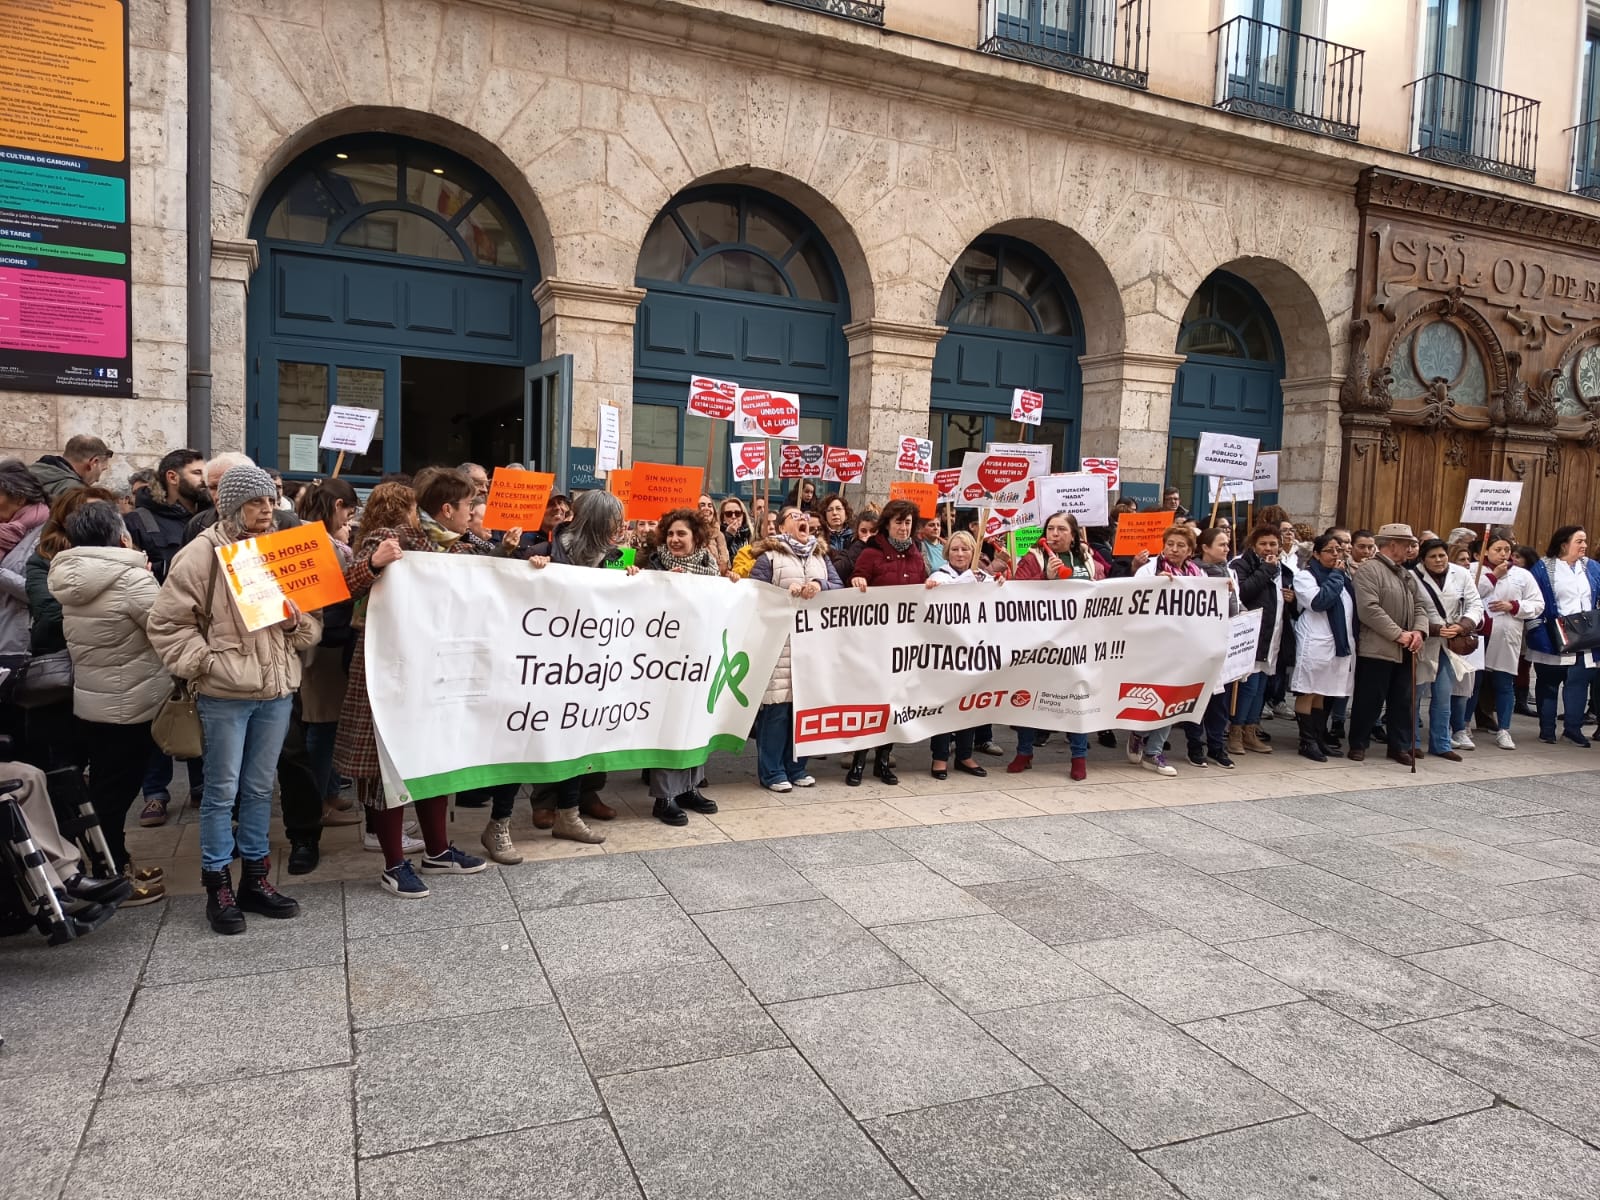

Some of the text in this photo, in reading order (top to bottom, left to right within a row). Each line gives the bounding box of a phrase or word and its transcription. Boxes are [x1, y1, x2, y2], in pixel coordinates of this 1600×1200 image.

[763, 419, 772, 428] LA
[1204, 457, 1248, 467] GARANTIZADO
[1056, 486, 1090, 494] DIPUTACIÓN
[279, 539, 319, 559] HORAS
[279, 562, 297, 577] NO
[300, 557, 316, 571] SE
[286, 573, 320, 591] VIVIR
[795, 589, 1222, 634] EL SERVICIO DE AYUDA A DOMICILIO RURAL SE AHOGA,
[521, 606, 681, 646] Colegio de
[892, 640, 1001, 674] DIPUTACIÓN
[1009, 644, 1087, 668] REACCIONA
[1094, 641, 1107, 662] YA
[515, 653, 711, 691] Trabajo Social
[958, 690, 1009, 711] UGT
[1165, 698, 1196, 717] CGT
[506, 700, 651, 732] de Burgos
[893, 704, 944, 726] hábitat
